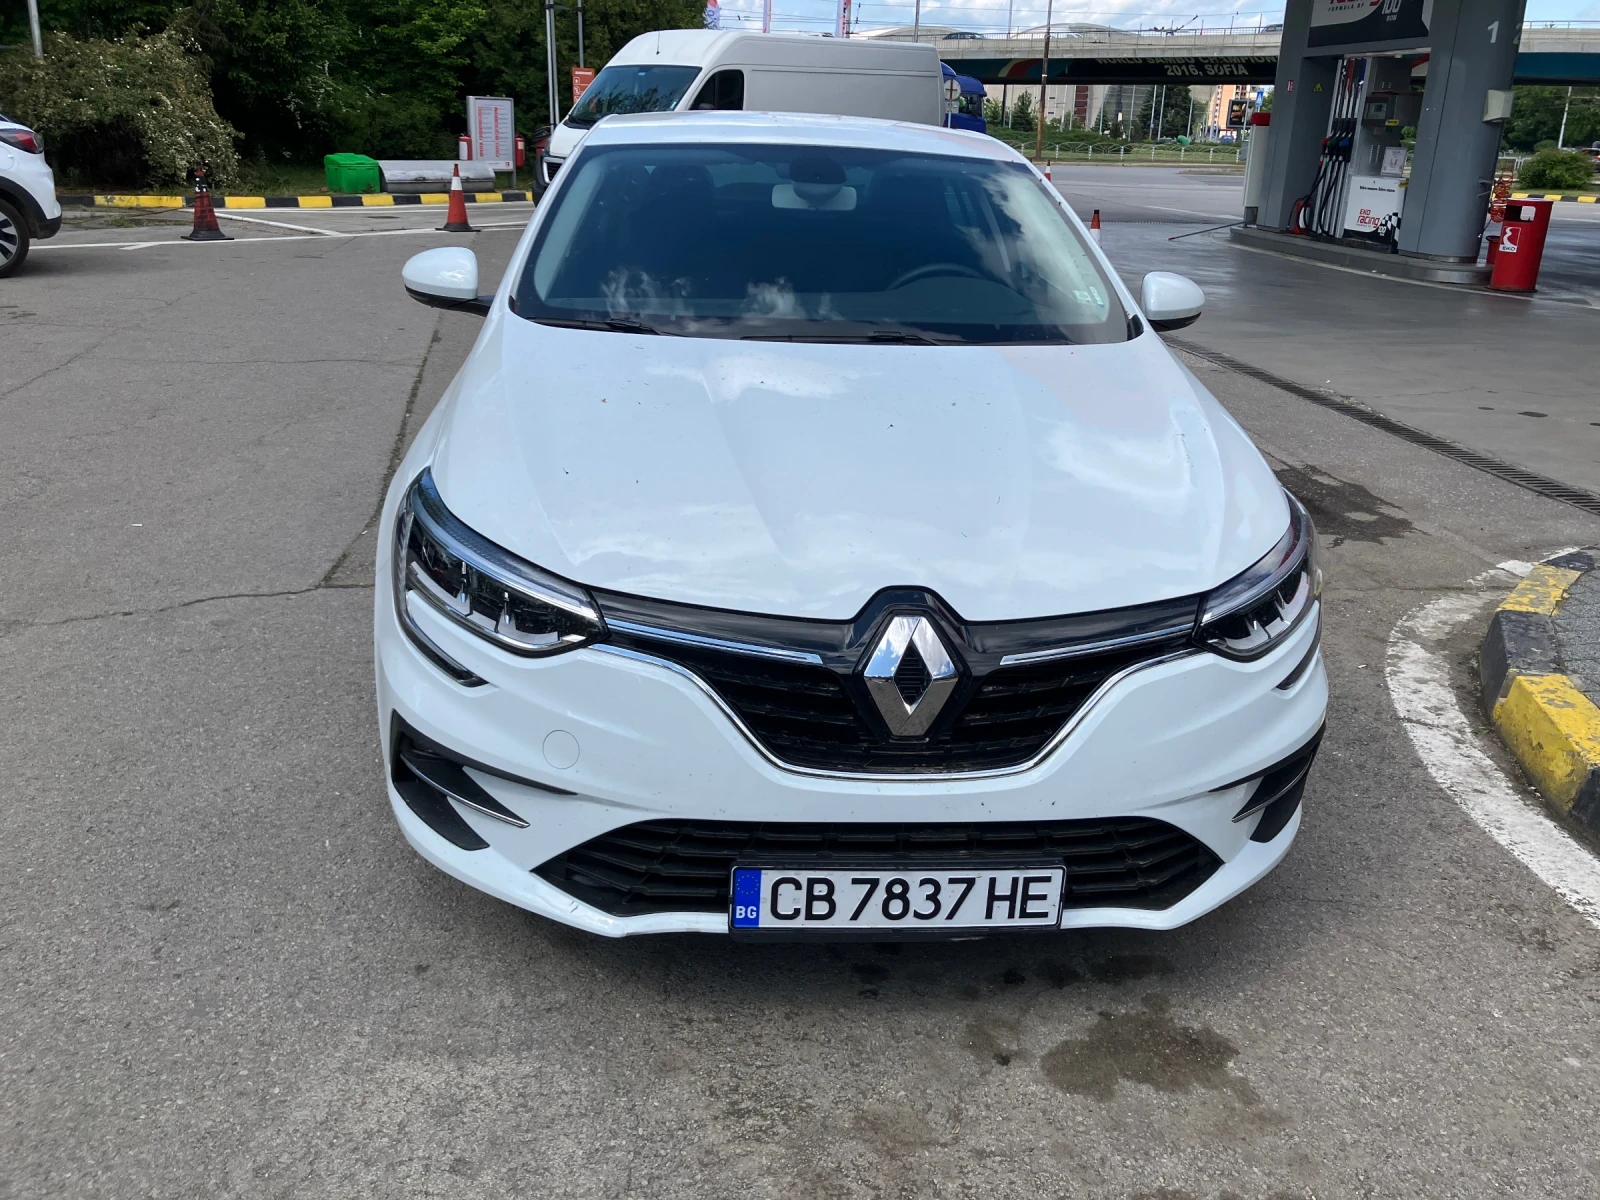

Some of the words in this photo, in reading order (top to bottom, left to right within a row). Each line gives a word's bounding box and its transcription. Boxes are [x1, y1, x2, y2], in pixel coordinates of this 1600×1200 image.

[1328, 4, 1354, 12] FORMULA
[1382, 0, 1402, 15] 100
[1487, 20, 1500, 43] 1
[1164, 64, 1204, 76] 2016,
[1204, 64, 1249, 75] SOFIA
[1357, 216, 1380, 228] racing
[769, 876, 837, 921] CB
[848, 876, 977, 921] 7837
[985, 875, 1053, 920] HE
[735, 905, 757, 919] BG
